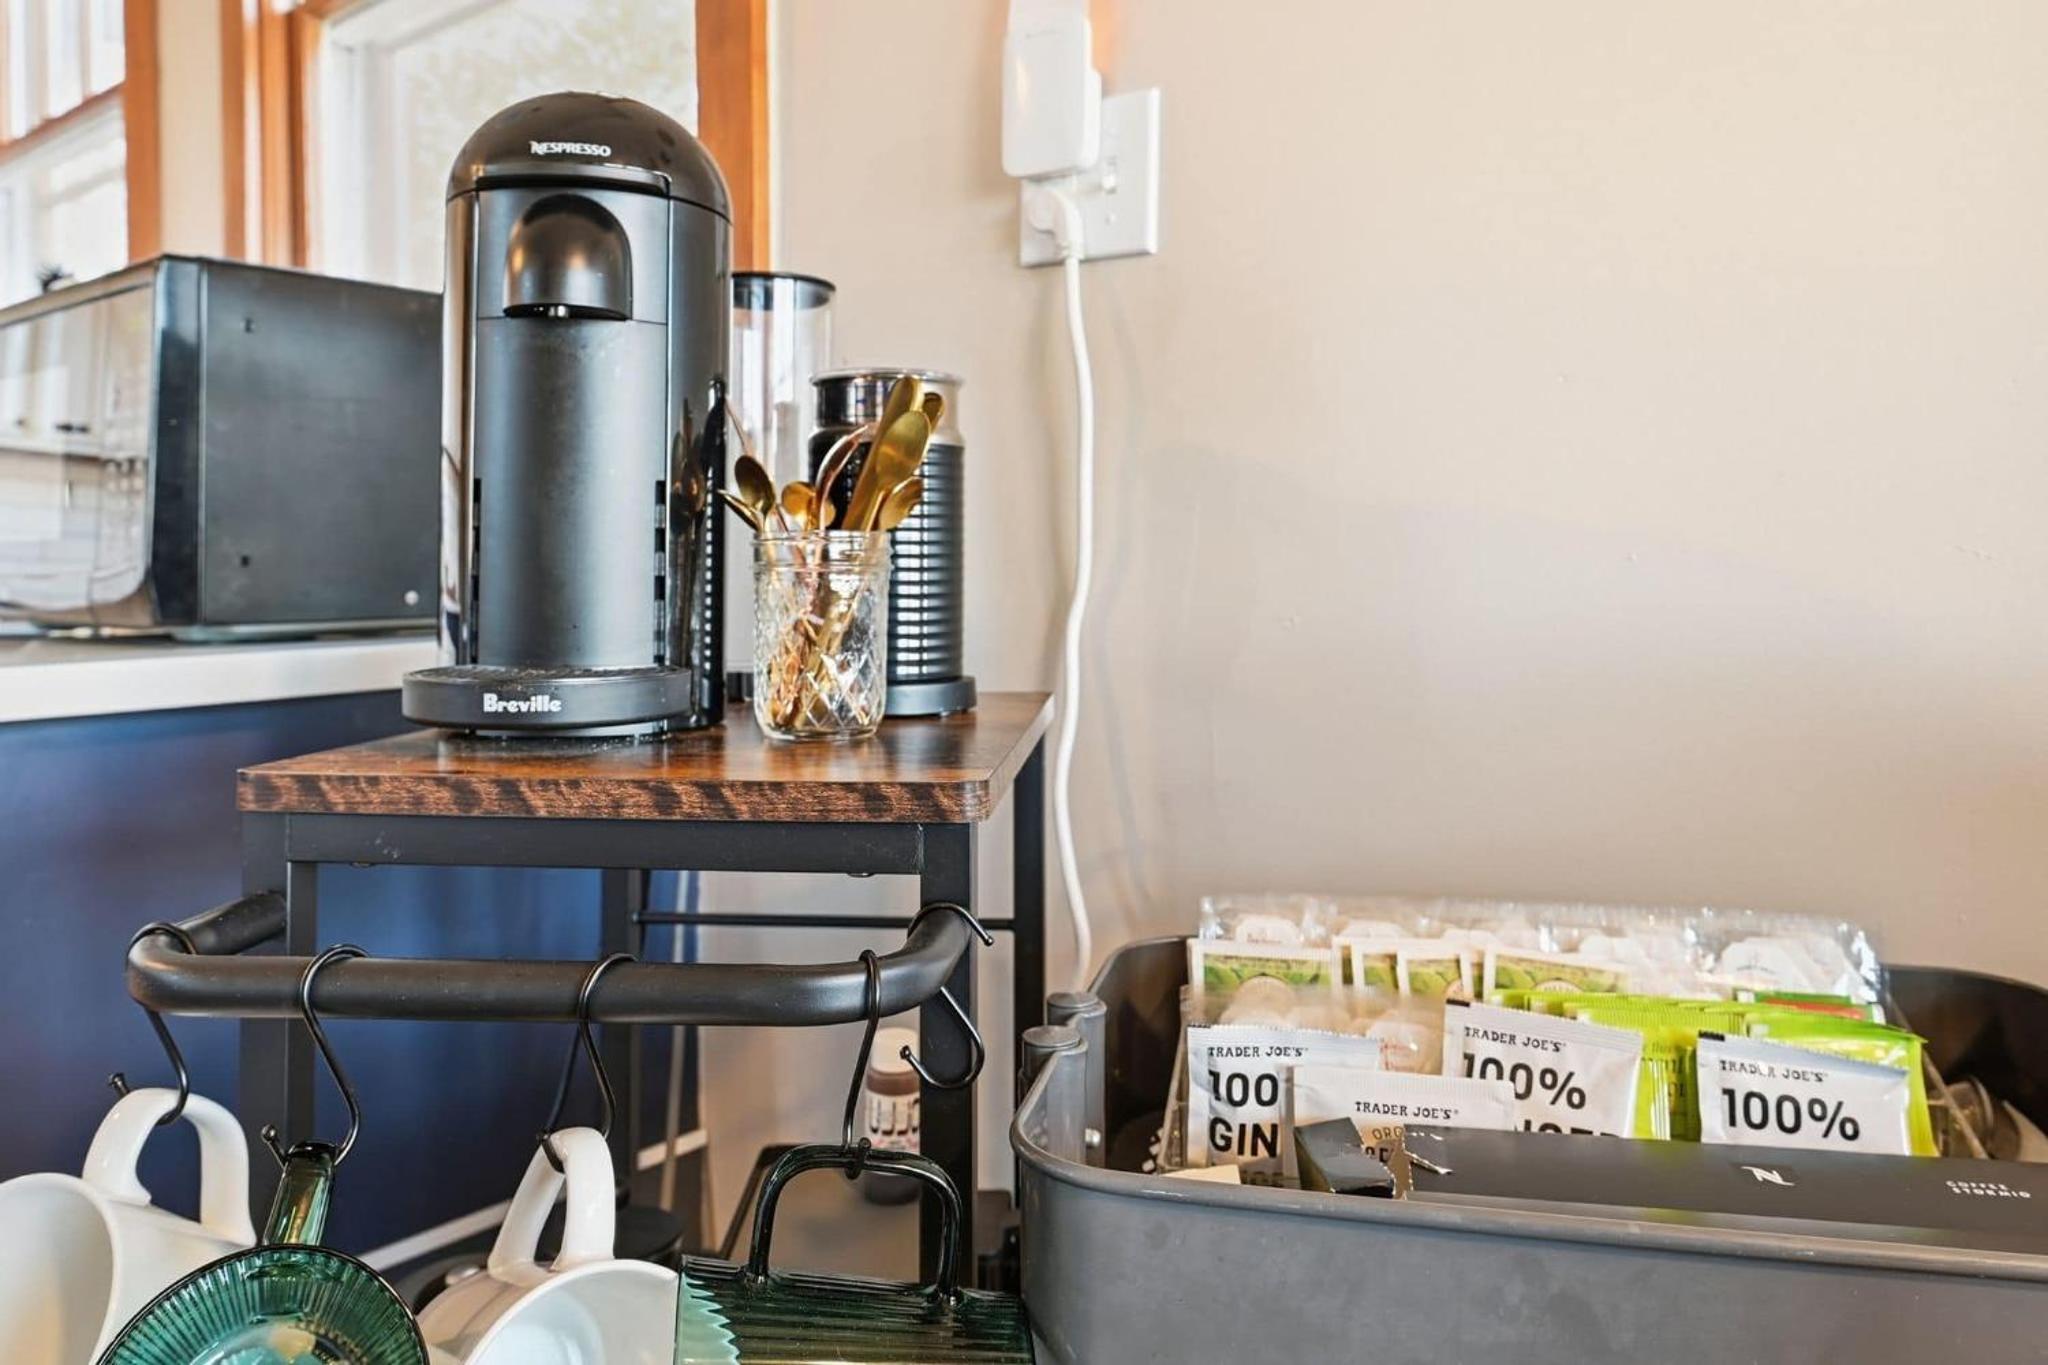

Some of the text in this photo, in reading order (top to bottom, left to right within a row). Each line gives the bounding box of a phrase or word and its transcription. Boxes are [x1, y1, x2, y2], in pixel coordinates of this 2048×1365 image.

[529, 140, 612, 157] NESPRESSO
[482, 693, 562, 713] Breville
[1464, 1026, 1561, 1052] TRADER JOE'S
[1208, 1046, 1303, 1058] TRADER JOE'S
[1463, 1053, 1586, 1110] 100%
[1782, 1069, 1823, 1082] JOE'S
[1209, 1070, 1279, 1107] 100
[1355, 1101, 1452, 1120] TRADER JOE'S
[1722, 1088, 1860, 1141] 100%
[1209, 1117, 1278, 1158] GIN
